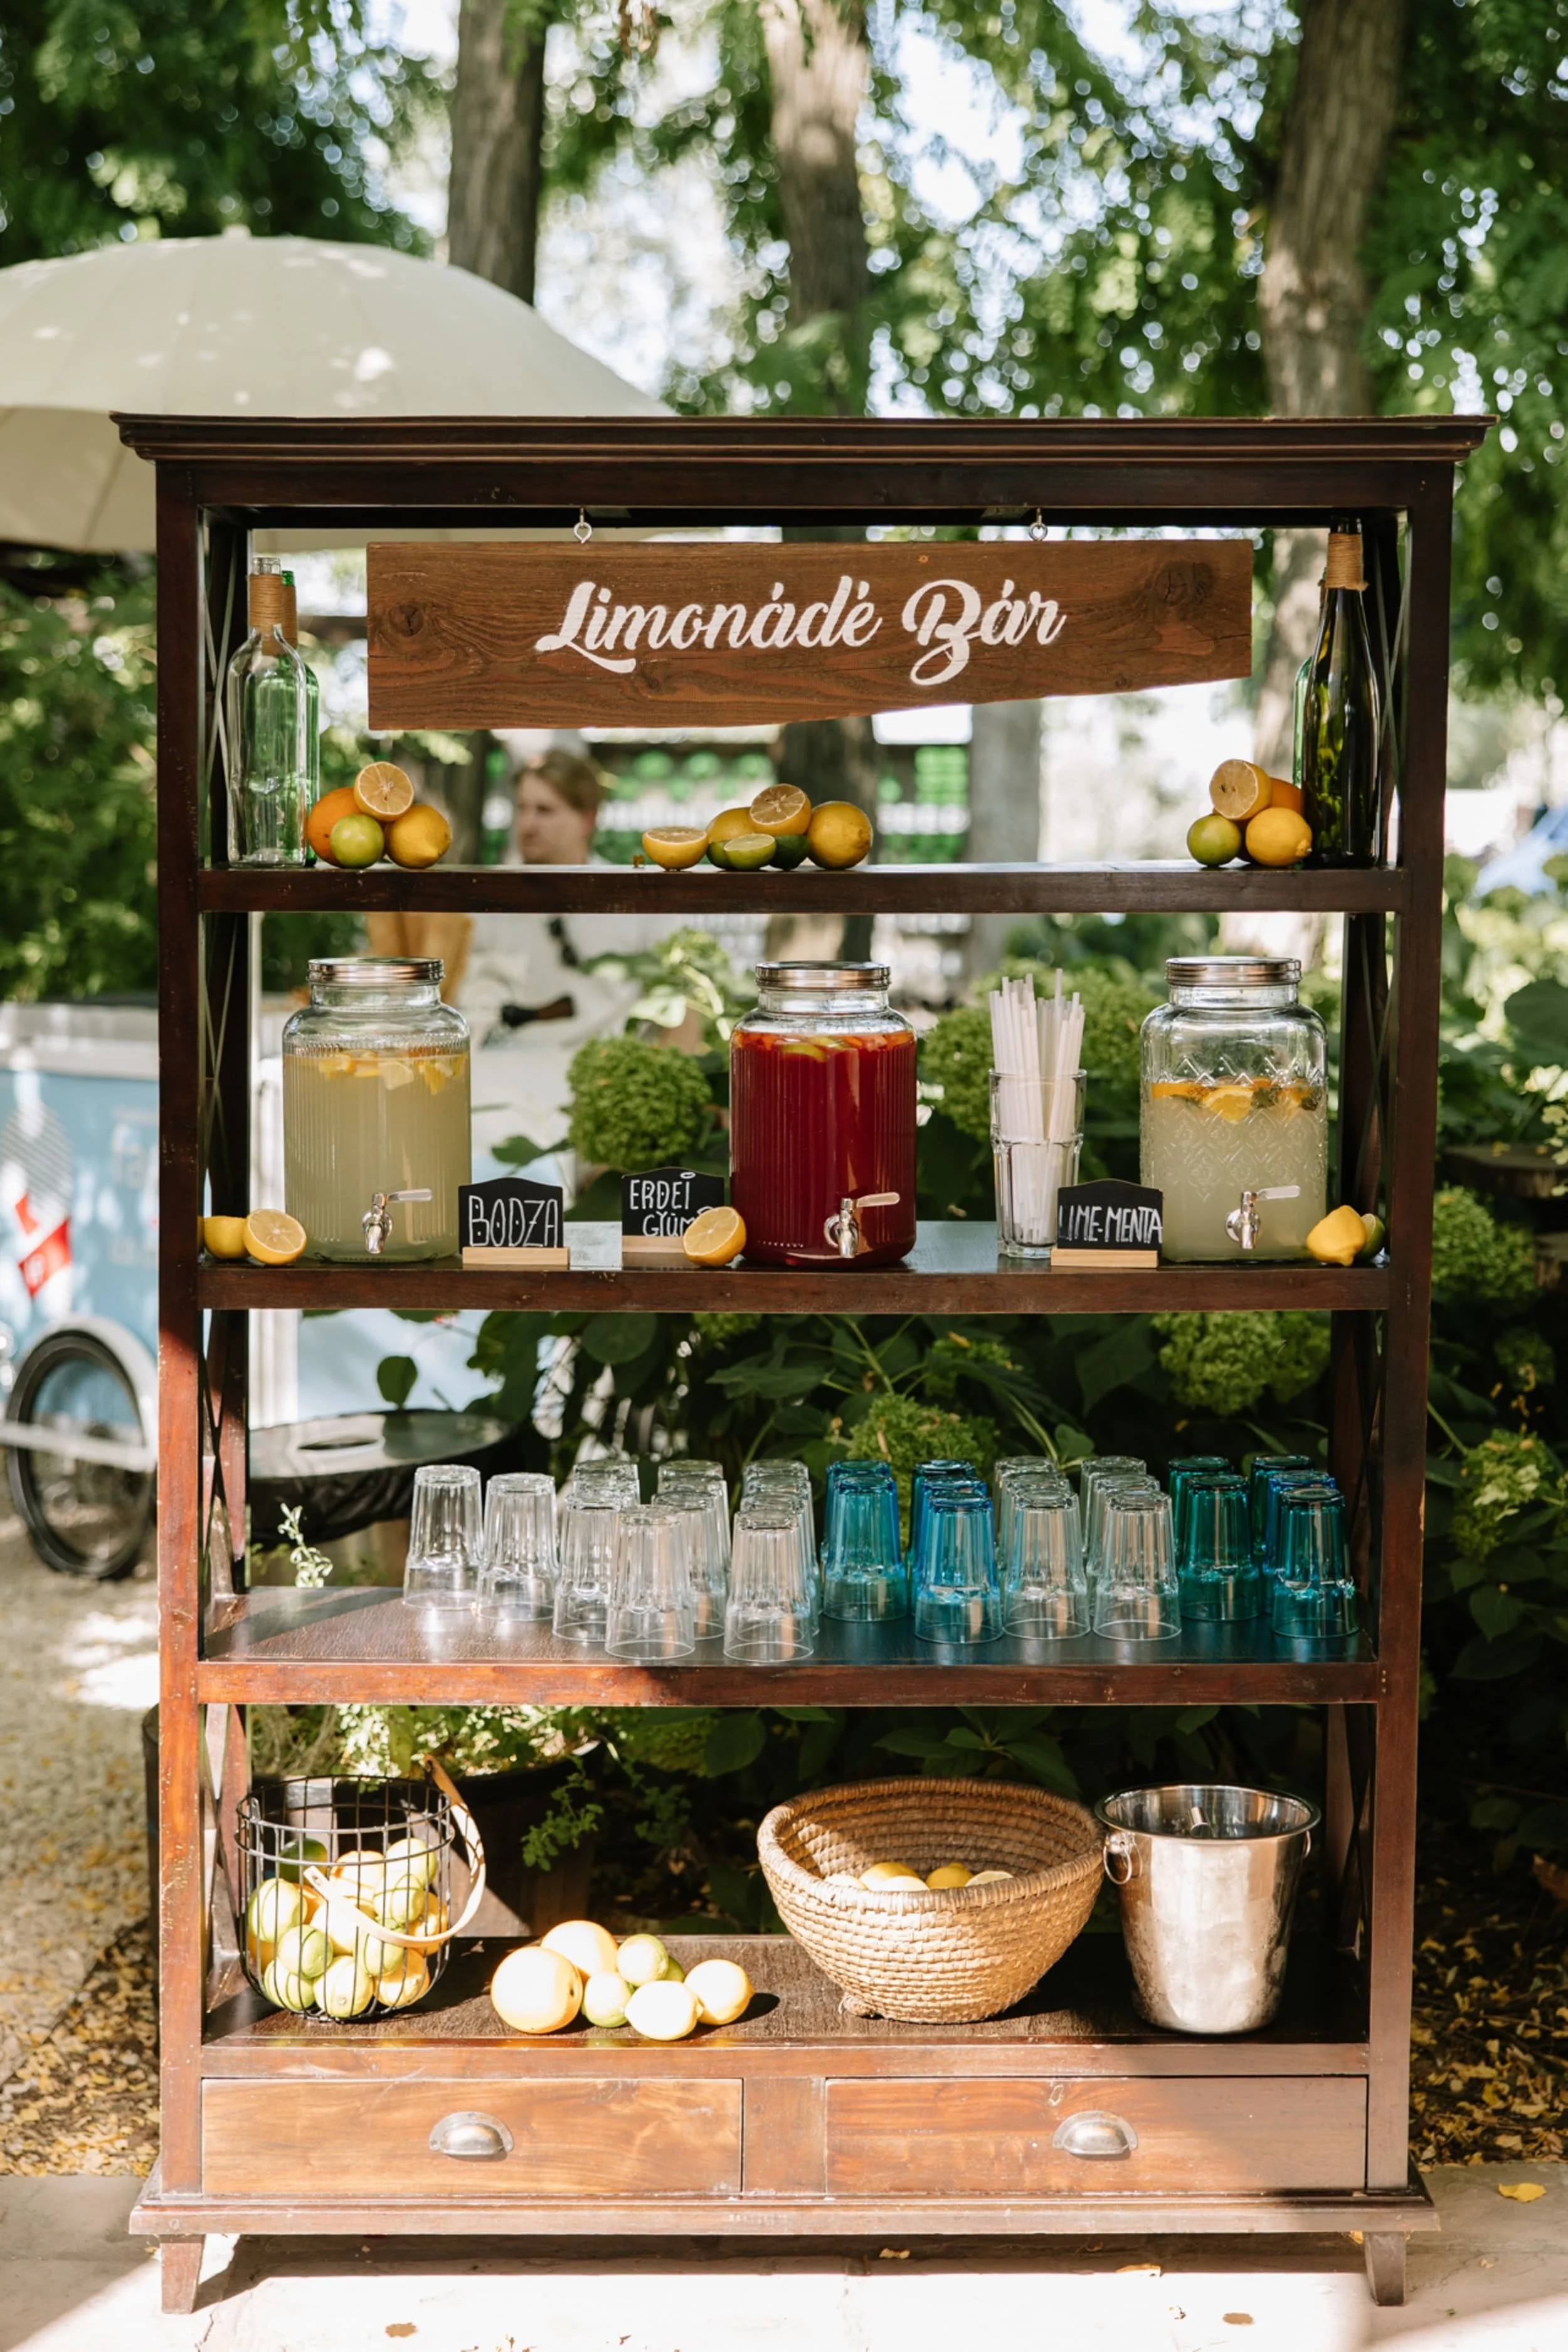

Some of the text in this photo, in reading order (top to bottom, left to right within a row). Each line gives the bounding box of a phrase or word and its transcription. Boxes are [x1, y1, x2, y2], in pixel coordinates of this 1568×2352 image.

[534, 575, 1067, 686] Limonádé Bár
[630, 1172, 696, 1210] ERDEI
[468, 1195, 559, 1248] BODZA
